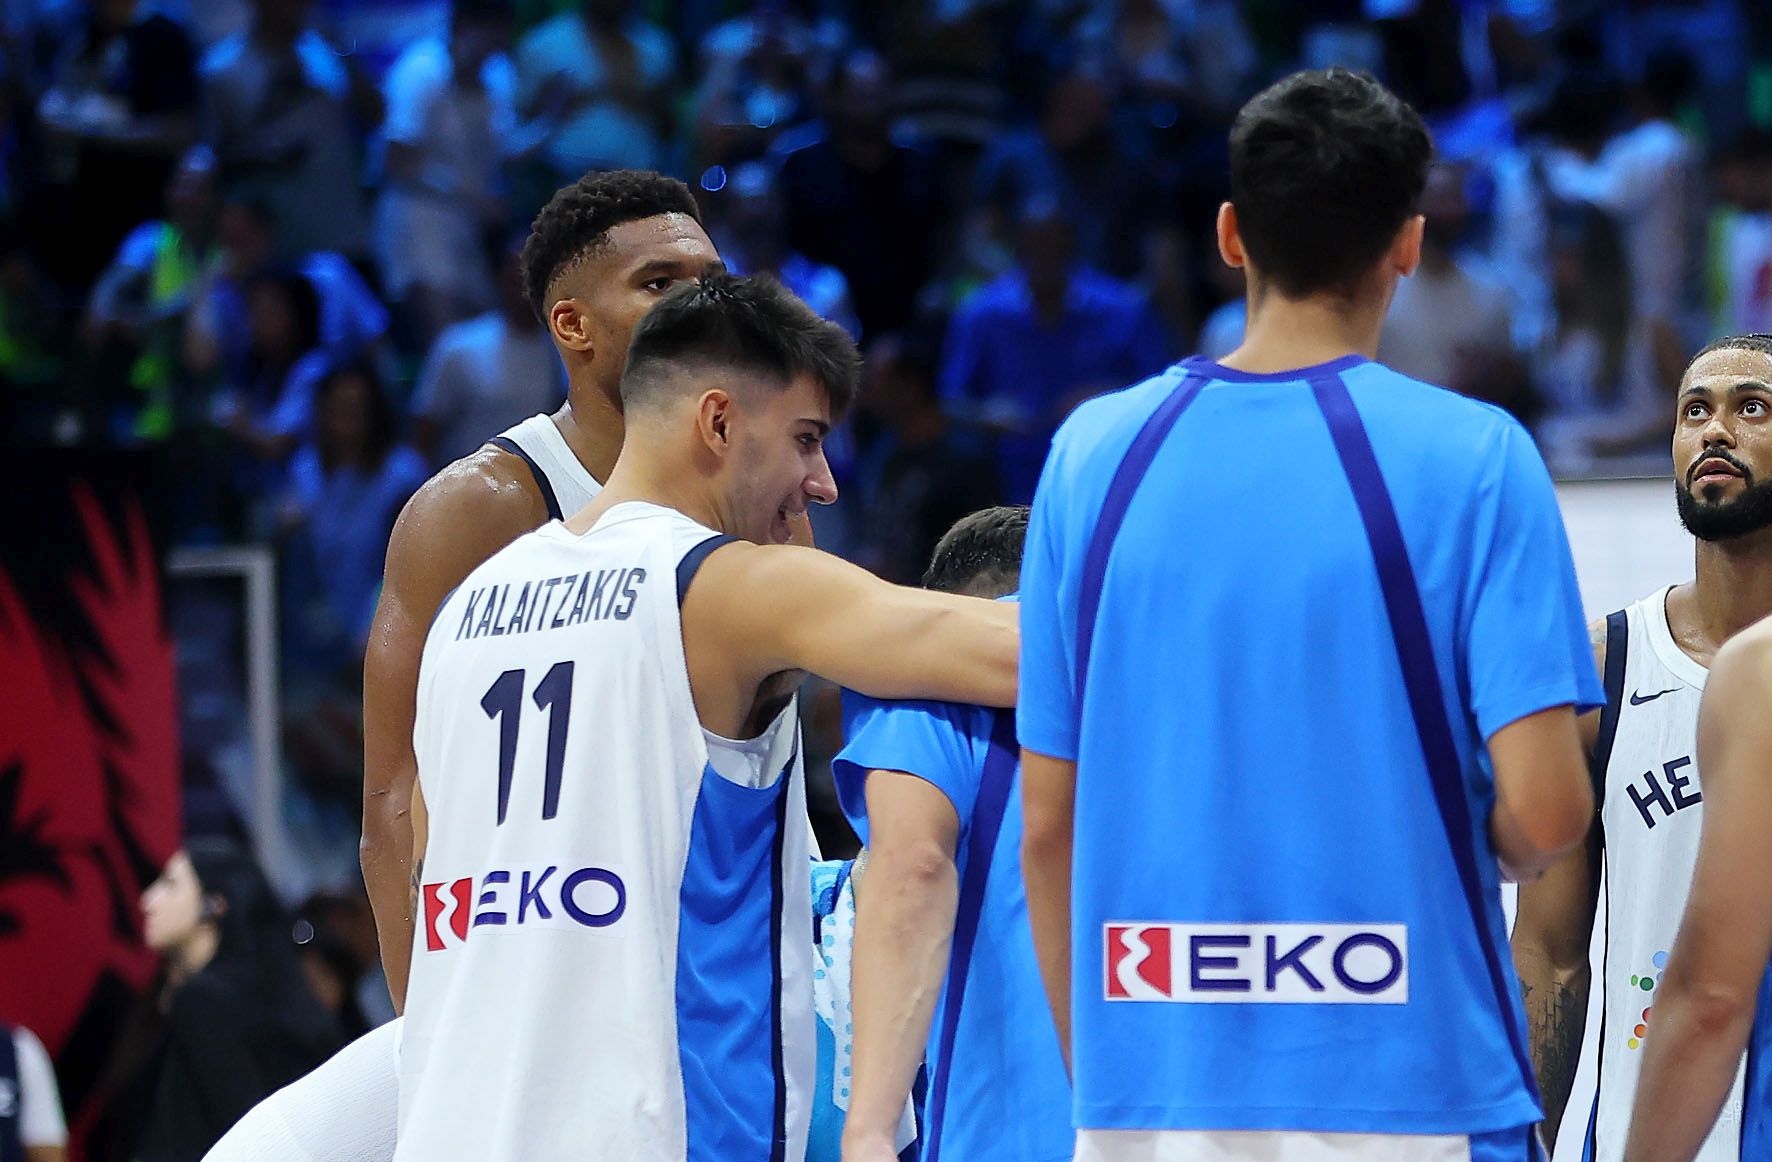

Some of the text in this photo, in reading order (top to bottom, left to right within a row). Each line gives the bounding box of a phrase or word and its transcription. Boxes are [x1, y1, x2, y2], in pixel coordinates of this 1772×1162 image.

[454, 567, 647, 641] KALAITZAKIS
[480, 660, 575, 826] 11
[472, 866, 626, 928] EKO
[1189, 932, 1404, 995] EKO
